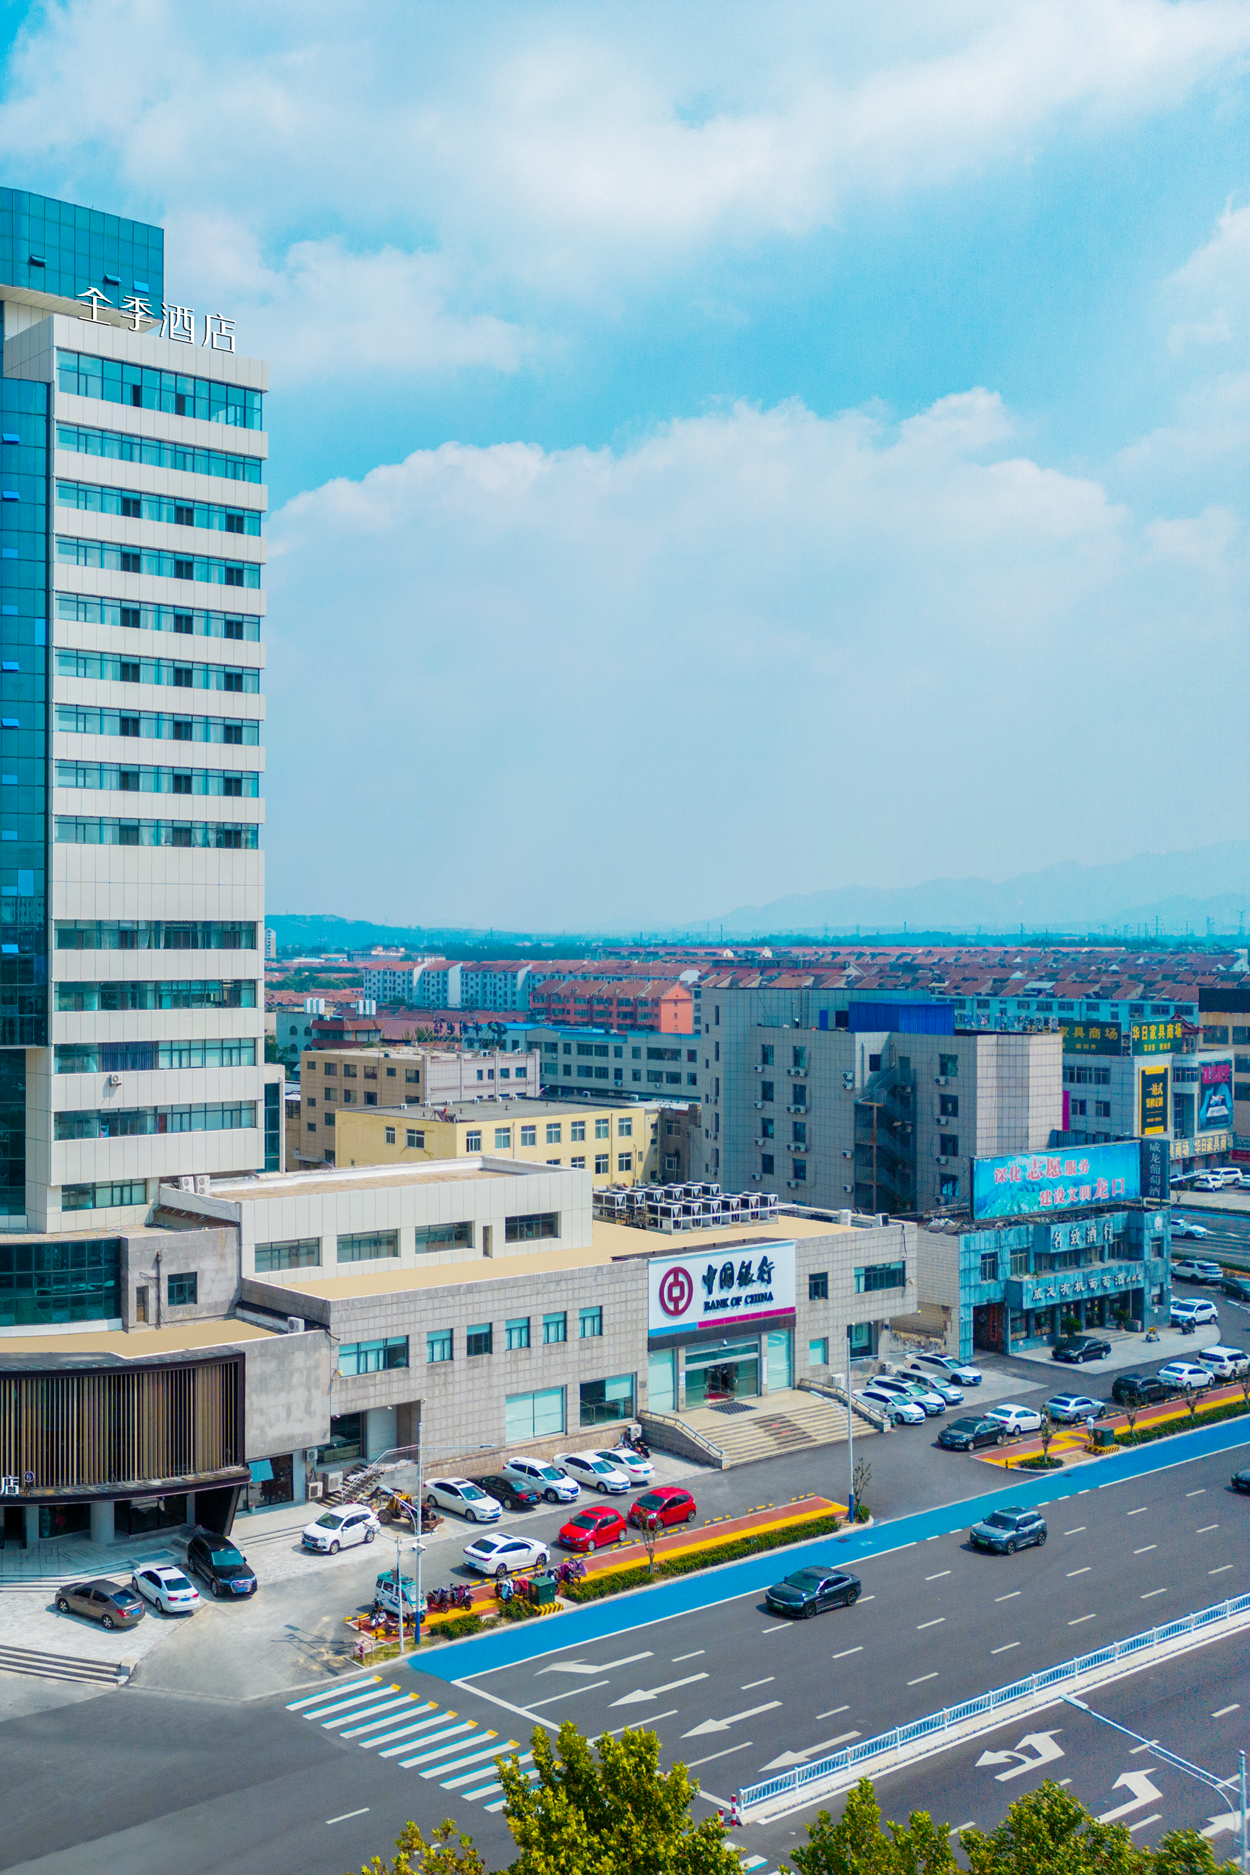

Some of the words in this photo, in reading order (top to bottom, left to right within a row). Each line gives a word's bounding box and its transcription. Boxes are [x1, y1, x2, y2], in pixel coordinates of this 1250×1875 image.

[76, 285, 237, 353] 全季酒店
[1132, 1022, 1182, 1041] 华日家具商场
[994, 1156, 1090, 1184] 深化志愿服务
[1149, 1142, 1161, 1197] 威龙葡萄酒
[1039, 1177, 1125, 1207] 建设文明龙口
[1052, 1222, 1114, 1249] 名致酒行
[701, 1256, 775, 1295] 中国银行
[704, 1299, 730, 1311] BANK
[730, 1297, 743, 1307] OF
[745, 1291, 774, 1305] CHINA
